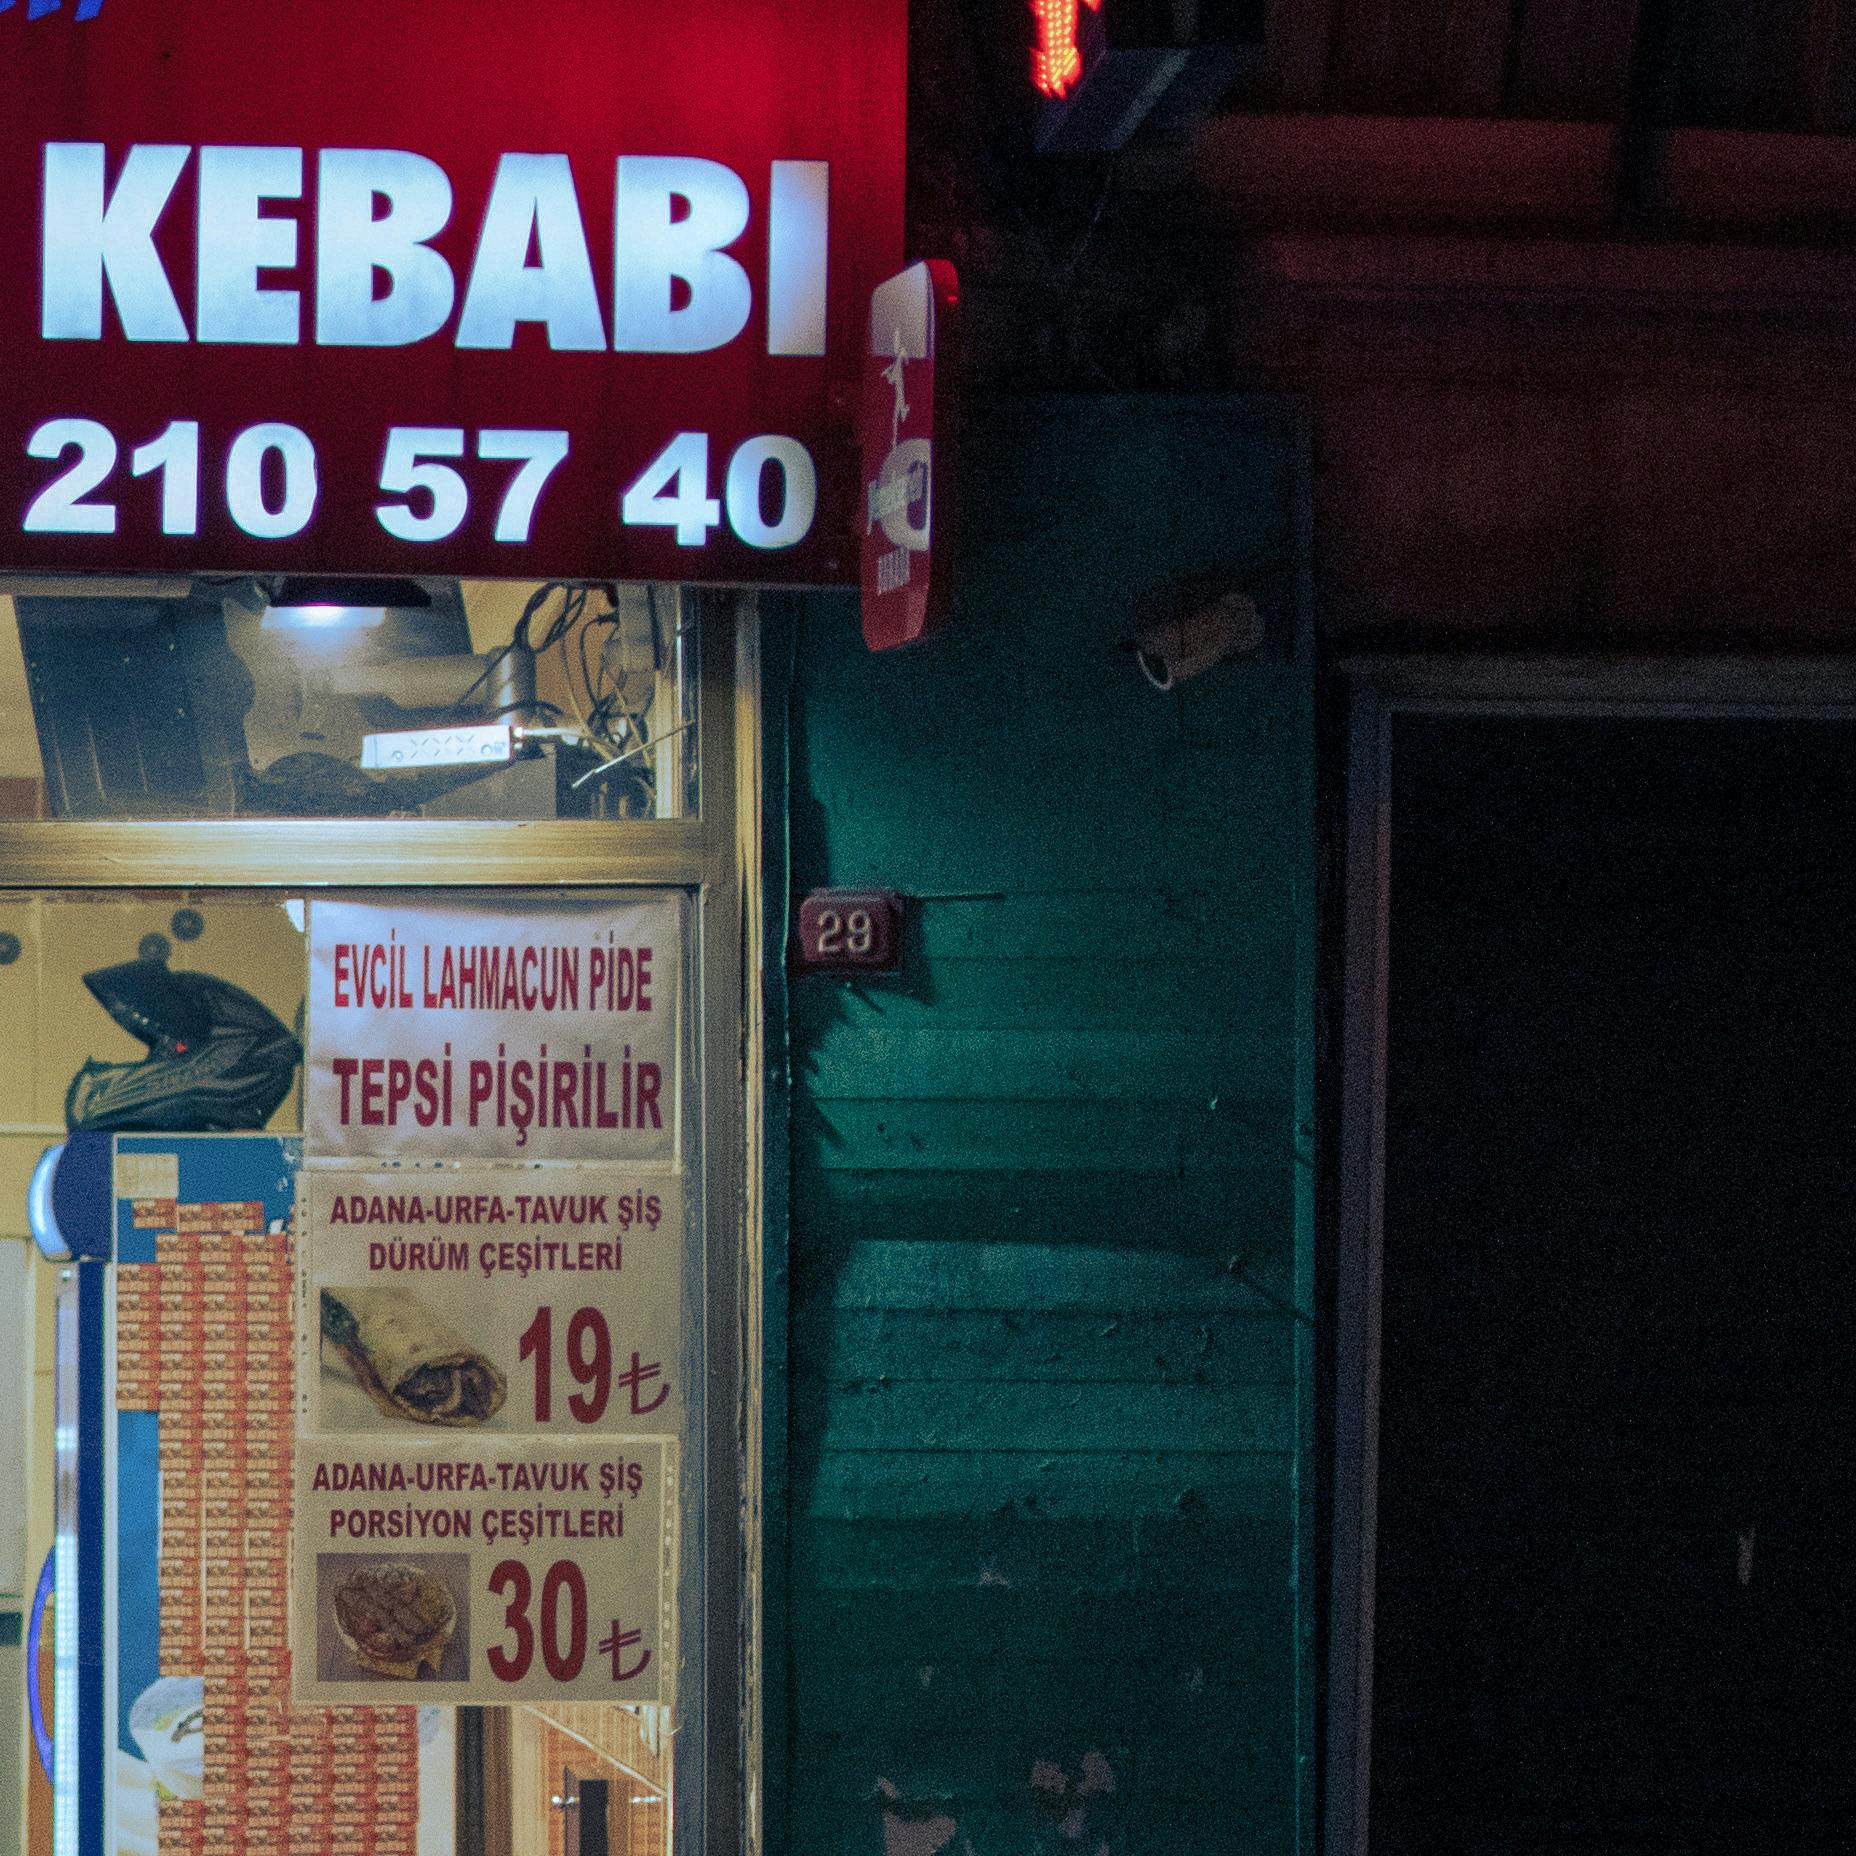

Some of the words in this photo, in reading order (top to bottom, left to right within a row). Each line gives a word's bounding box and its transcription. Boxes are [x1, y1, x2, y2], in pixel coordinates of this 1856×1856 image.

[41, 142, 828, 355] KEBABI
[22, 418, 318, 539] 210
[375, 426, 569, 543] 57
[621, 432, 815, 549] 40
[816, 910, 873, 954] 29
[333, 927, 414, 1010] EVCİL
[422, 945, 579, 1011] LAHMACUN
[588, 930, 653, 1011] PİDE
[332, 1041, 452, 1127] TEPSİ
[468, 1044, 663, 1146] PİŞİRİLİR
[329, 1194, 608, 1225] ADANA-URFA-TAVUK
[617, 1187, 663, 1232] ŞİŞ
[368, 1239, 470, 1272] DÜRÜM
[479, 1234, 623, 1278] ÇEŞİTLERİ
[312, 1462, 589, 1492] ADANA-URFA-TAVUK
[598, 1455, 644, 1499] ŞİŞ
[329, 1502, 472, 1539] PORSİYON
[481, 1501, 625, 1546] ÇEŞİTLERİ
